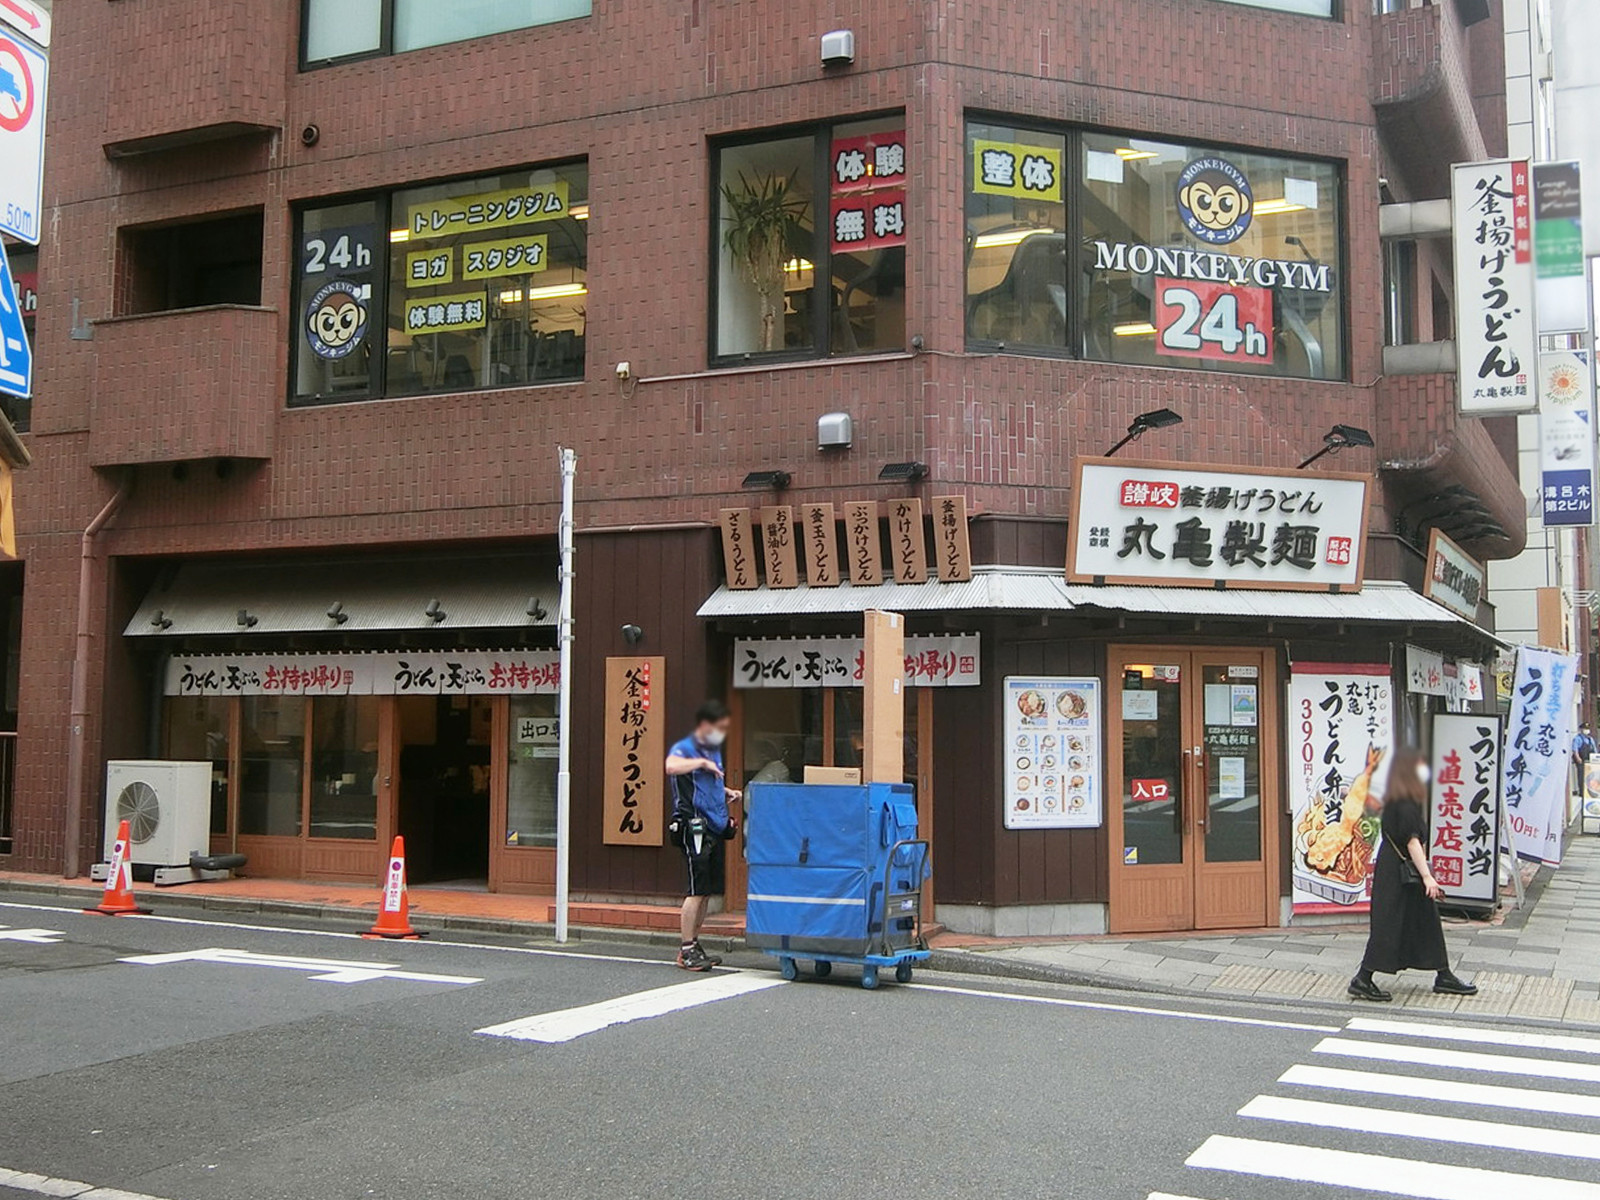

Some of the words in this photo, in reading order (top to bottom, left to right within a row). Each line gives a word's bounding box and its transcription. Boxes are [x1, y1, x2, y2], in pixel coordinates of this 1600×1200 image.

[836, 143, 904, 182] 体験
[981, 148, 1055, 191] 整体
[1183, 159, 1246, 188] MONKEYGYM
[7, 203, 32, 235] 50m
[413, 193, 562, 234] トレーニングジム
[835, 203, 904, 242] 無料
[1188, 217, 1244, 240] モンキージム
[305, 236, 371, 273] 24h
[411, 254, 448, 281] ヨガ
[466, 243, 543, 273] スタジオ
[1094, 241, 1330, 292] MONKEYGYM
[1467, 174, 1521, 378] 釜揚げうどん
[408, 299, 484, 328] 体験無料
[1163, 287, 1267, 356] 24h
[1123, 483, 1178, 506] 讃岐
[1180, 485, 1323, 515] 釜揚げうどん
[1545, 499, 1591, 512] 第2ビル
[810, 508, 829, 582] 釜玉うどん
[897, 503, 916, 580] かけうどん
[942, 500, 961, 578] 釜揚げうどん
[1116, 516, 1319, 570] 丸亀製麺
[180, 659, 261, 691] うどん・天ぷら
[263, 664, 342, 690] お持ち帰り
[394, 661, 486, 690] うどん・天ぷら
[741, 650, 848, 682] うどん・天ぷら
[1346, 681, 1363, 716] 丸亀
[1364, 681, 1379, 739] 打ち立て
[619, 668, 647, 834] 釜揚げうどん
[1319, 680, 1345, 825] うどん弁当
[1506, 667, 1543, 809] うどん弁当
[1535, 723, 1556, 757] 丸亀
[1133, 782, 1168, 798] 入口
[1432, 749, 1465, 852] 直売店
[1466, 726, 1495, 876] うどん弁当
